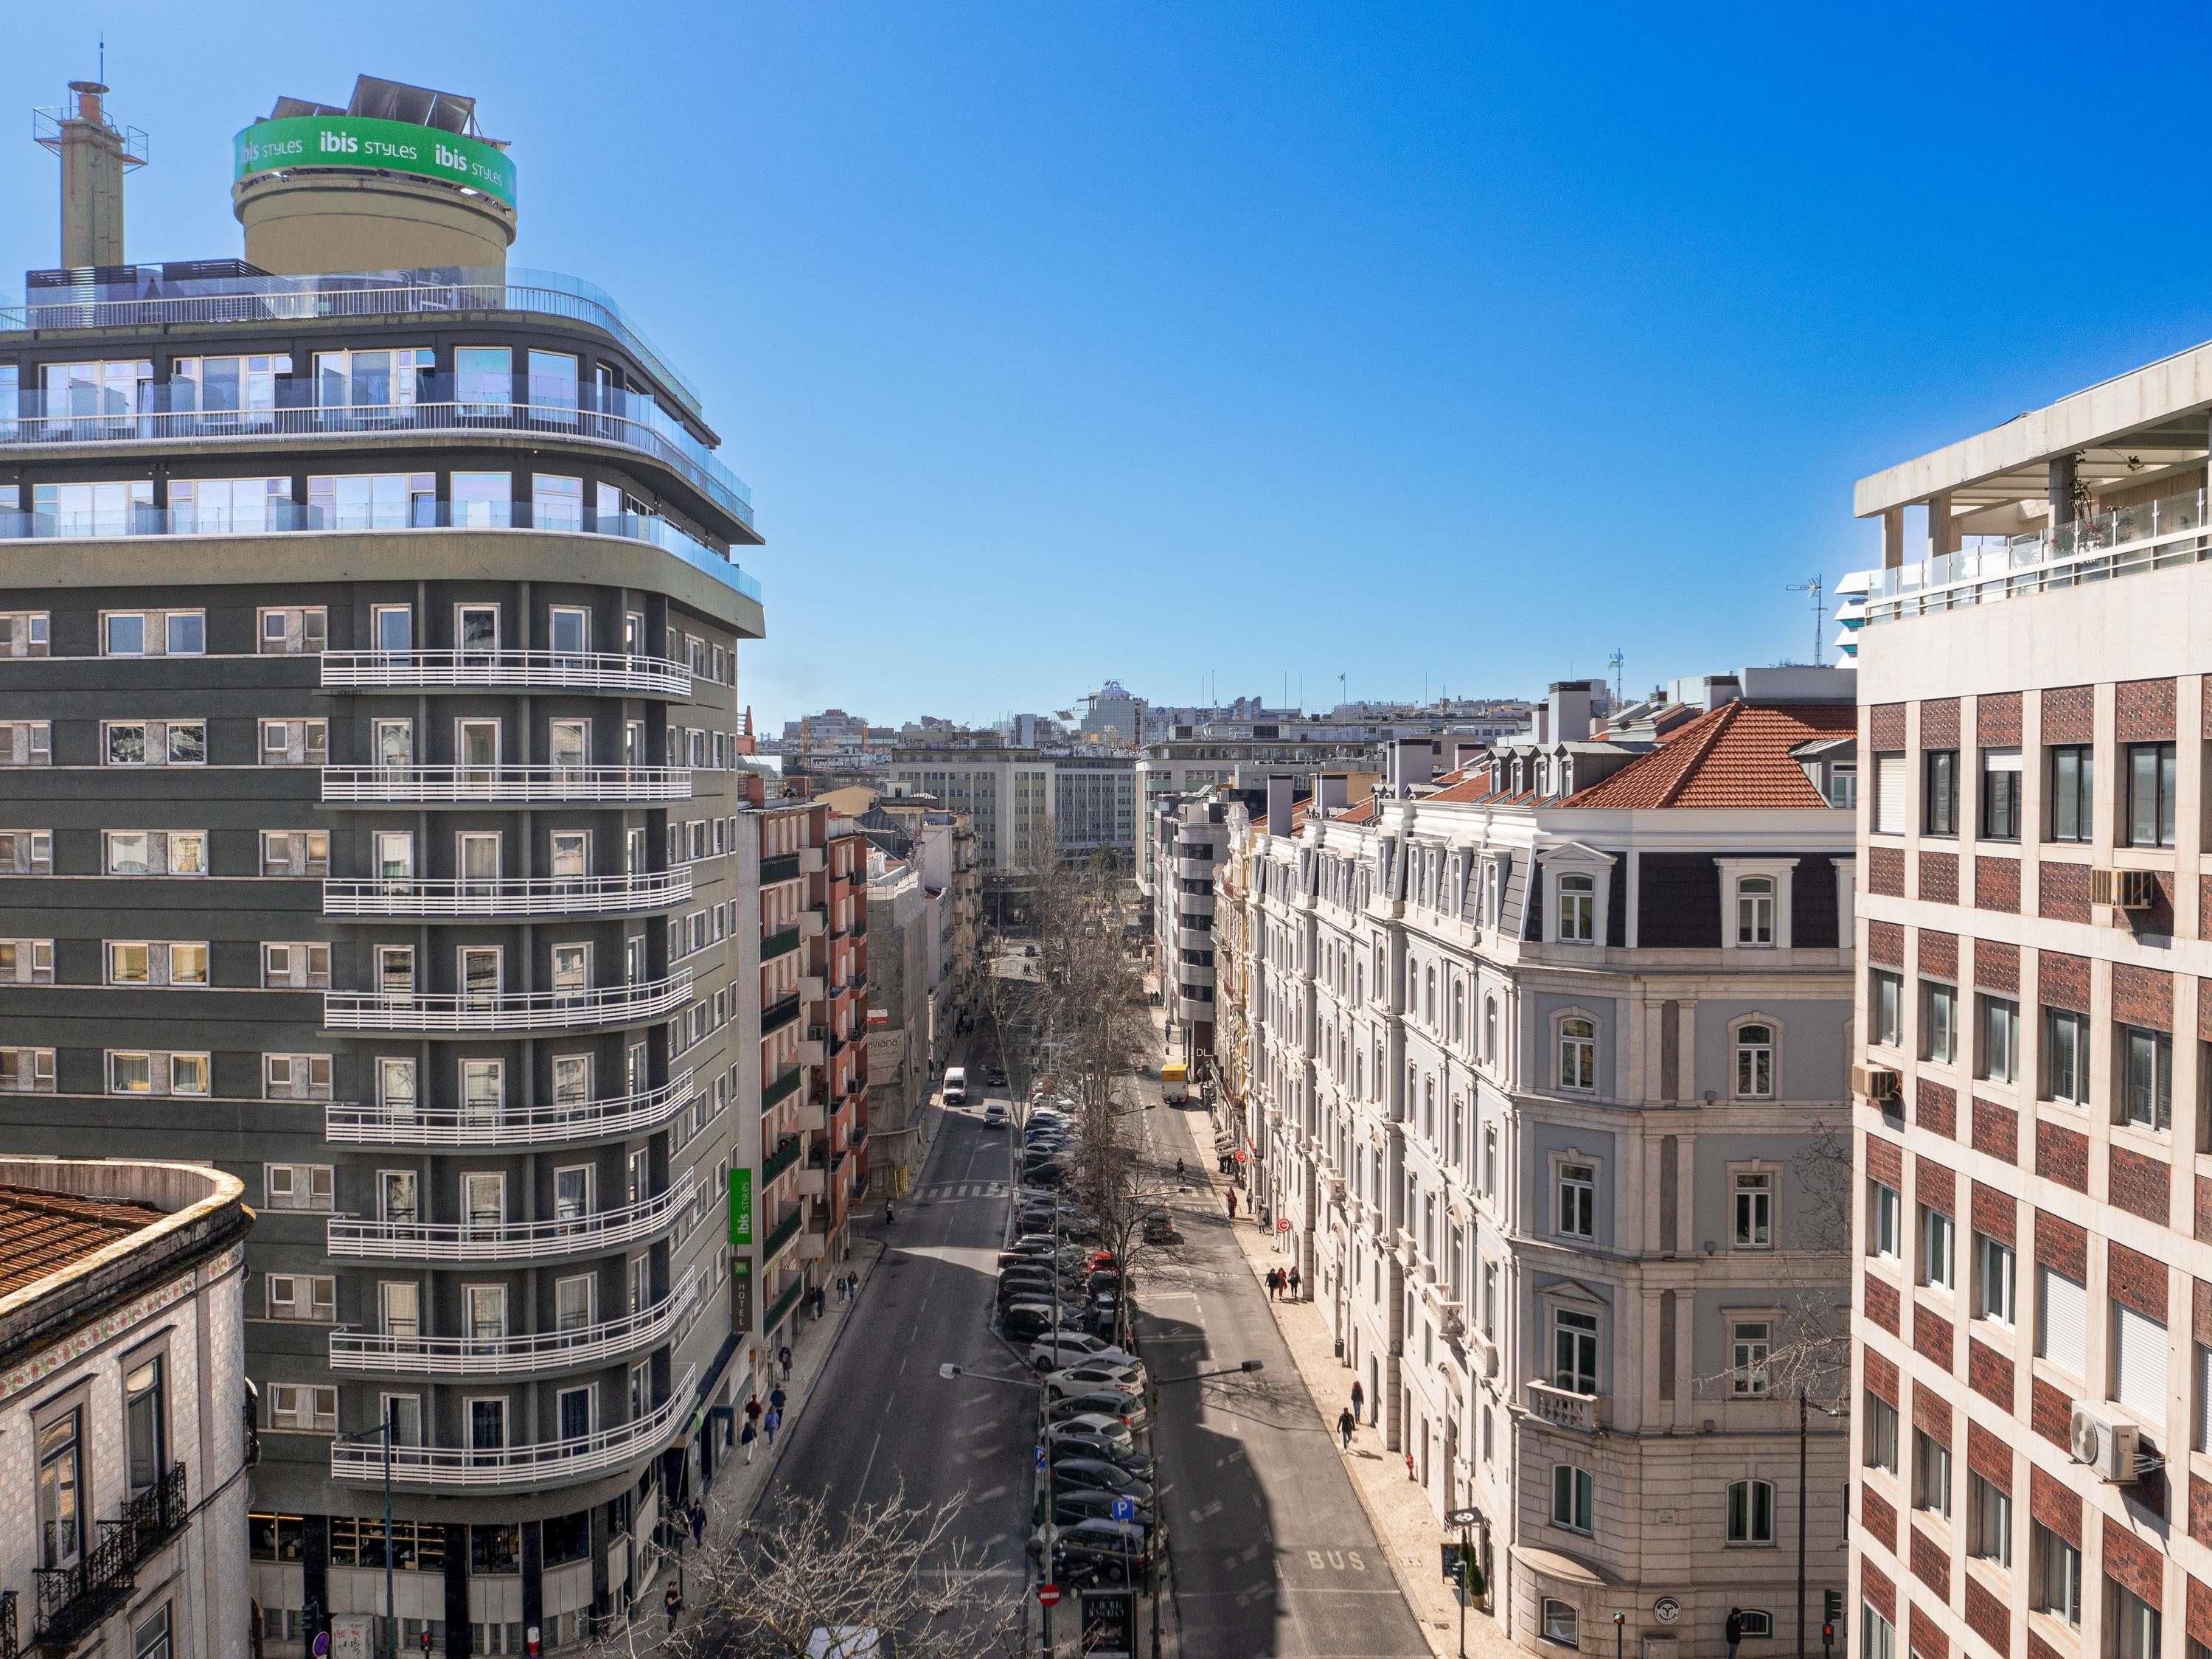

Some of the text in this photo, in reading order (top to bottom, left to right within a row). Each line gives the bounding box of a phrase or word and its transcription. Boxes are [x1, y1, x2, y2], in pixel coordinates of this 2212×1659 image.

[320, 131, 358, 153] ibis
[435, 144, 467, 172] ibis
[737, 1214, 749, 1234] ibis
[1118, 1501, 1127, 1516] P
[1306, 1550, 1366, 1572] BUS
